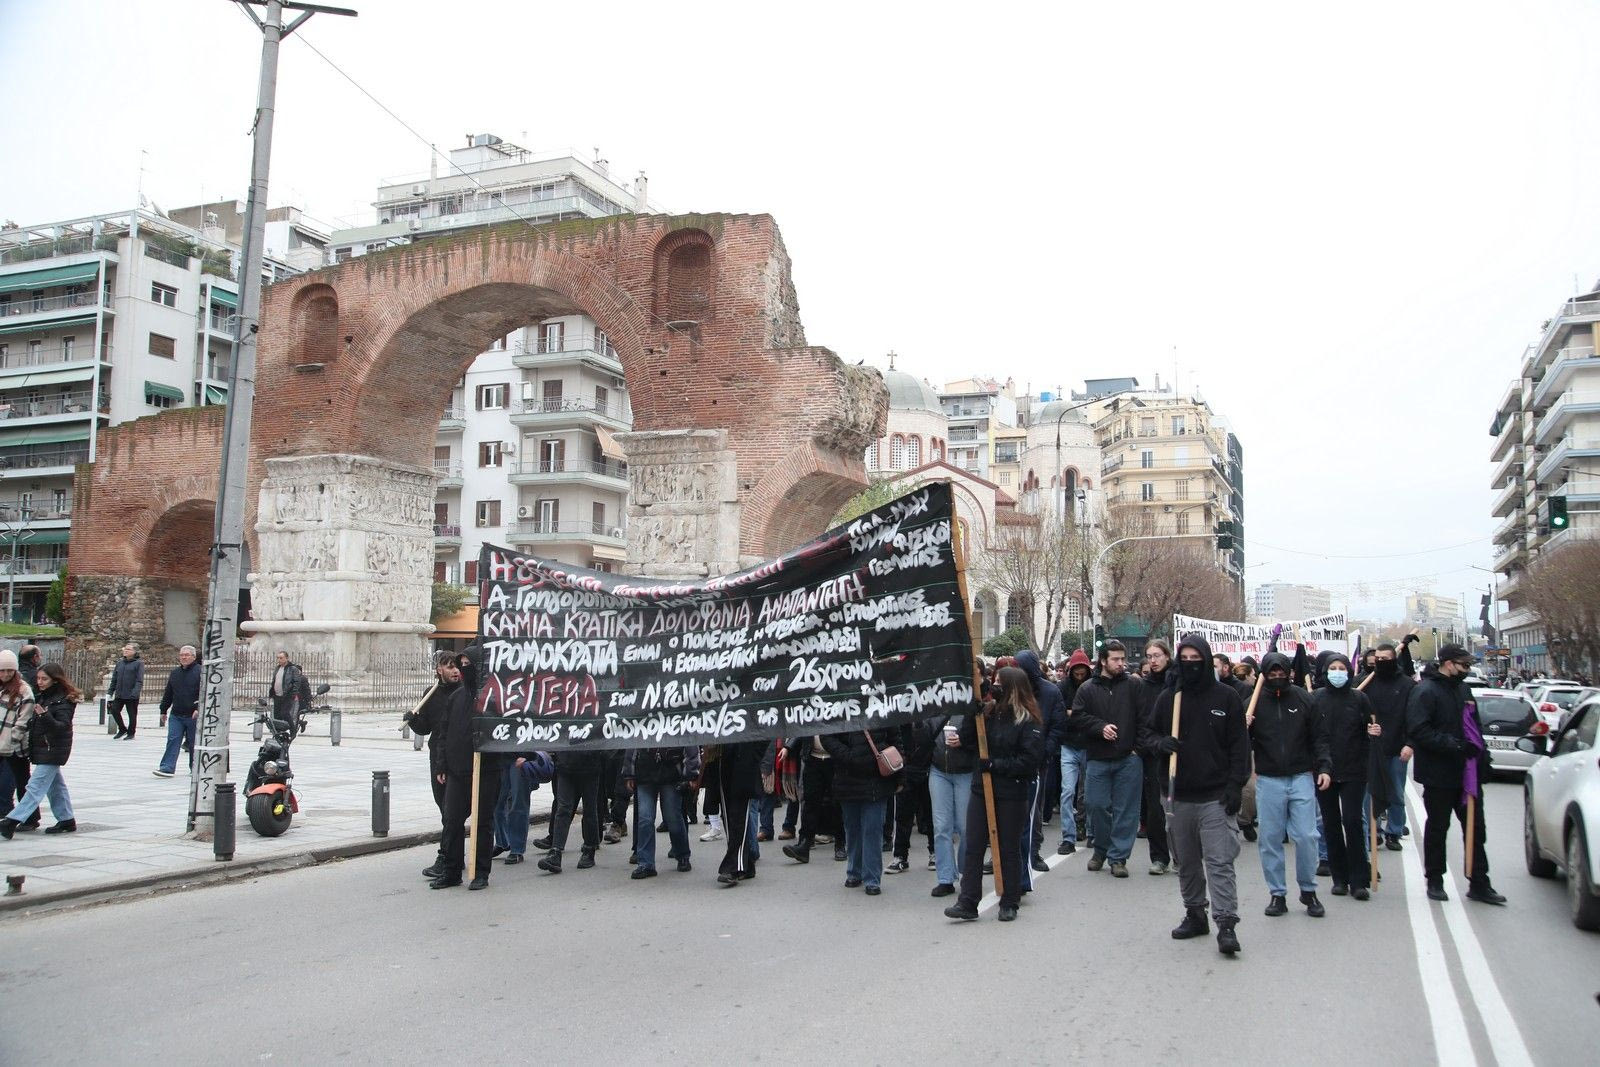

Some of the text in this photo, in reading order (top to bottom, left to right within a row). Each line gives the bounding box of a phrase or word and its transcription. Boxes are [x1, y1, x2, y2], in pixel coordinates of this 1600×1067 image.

[484, 608, 556, 639] ΚΑΜΙΑ
[563, 609, 644, 639] ΚΡΑΤΙΚΗ
[758, 572, 865, 626] ΑΝΑΠΑΝΤΗΤΗ
[483, 637, 618, 677] ΤΡΟΜΟΚΡΑΤΙΑ
